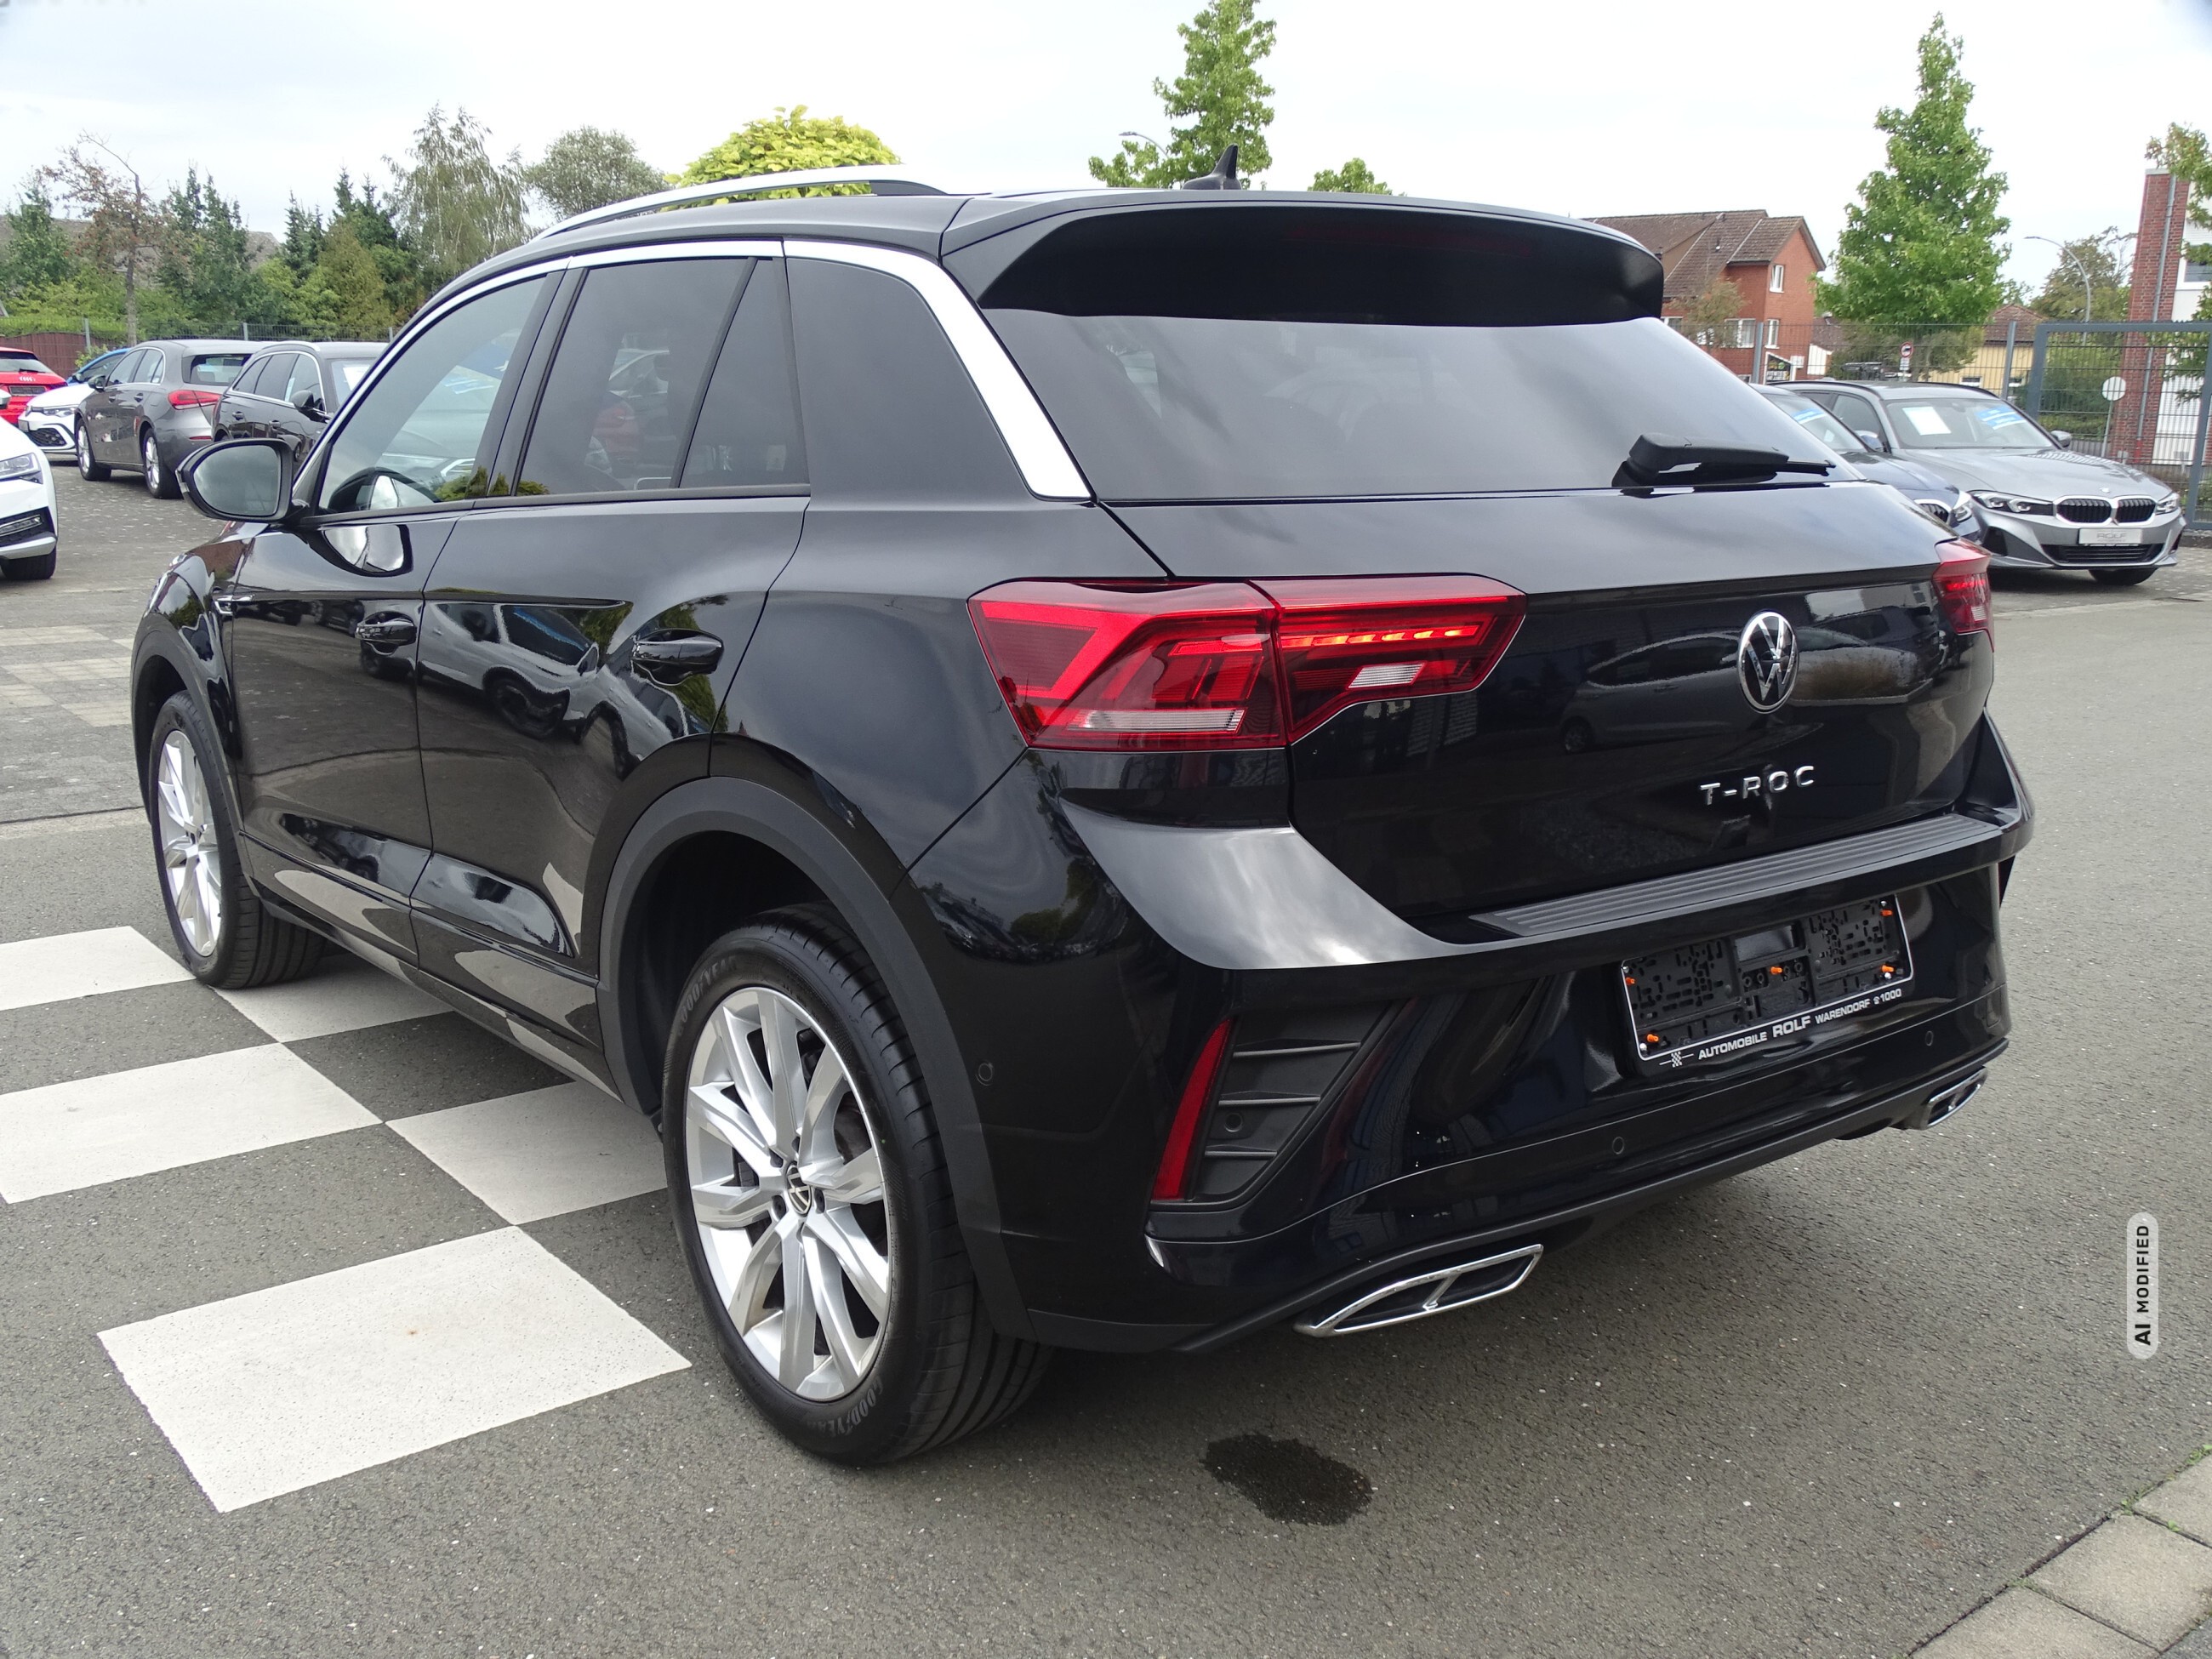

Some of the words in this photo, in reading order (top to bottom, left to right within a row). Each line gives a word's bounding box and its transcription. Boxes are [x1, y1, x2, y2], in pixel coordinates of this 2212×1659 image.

[1700, 766, 1815, 806] T-ROC
[1698, 1031, 1768, 1060] AUTOMOBILE
[1772, 1015, 1810, 1038] ROLF
[1815, 998, 1871, 1024] WARENDORF
